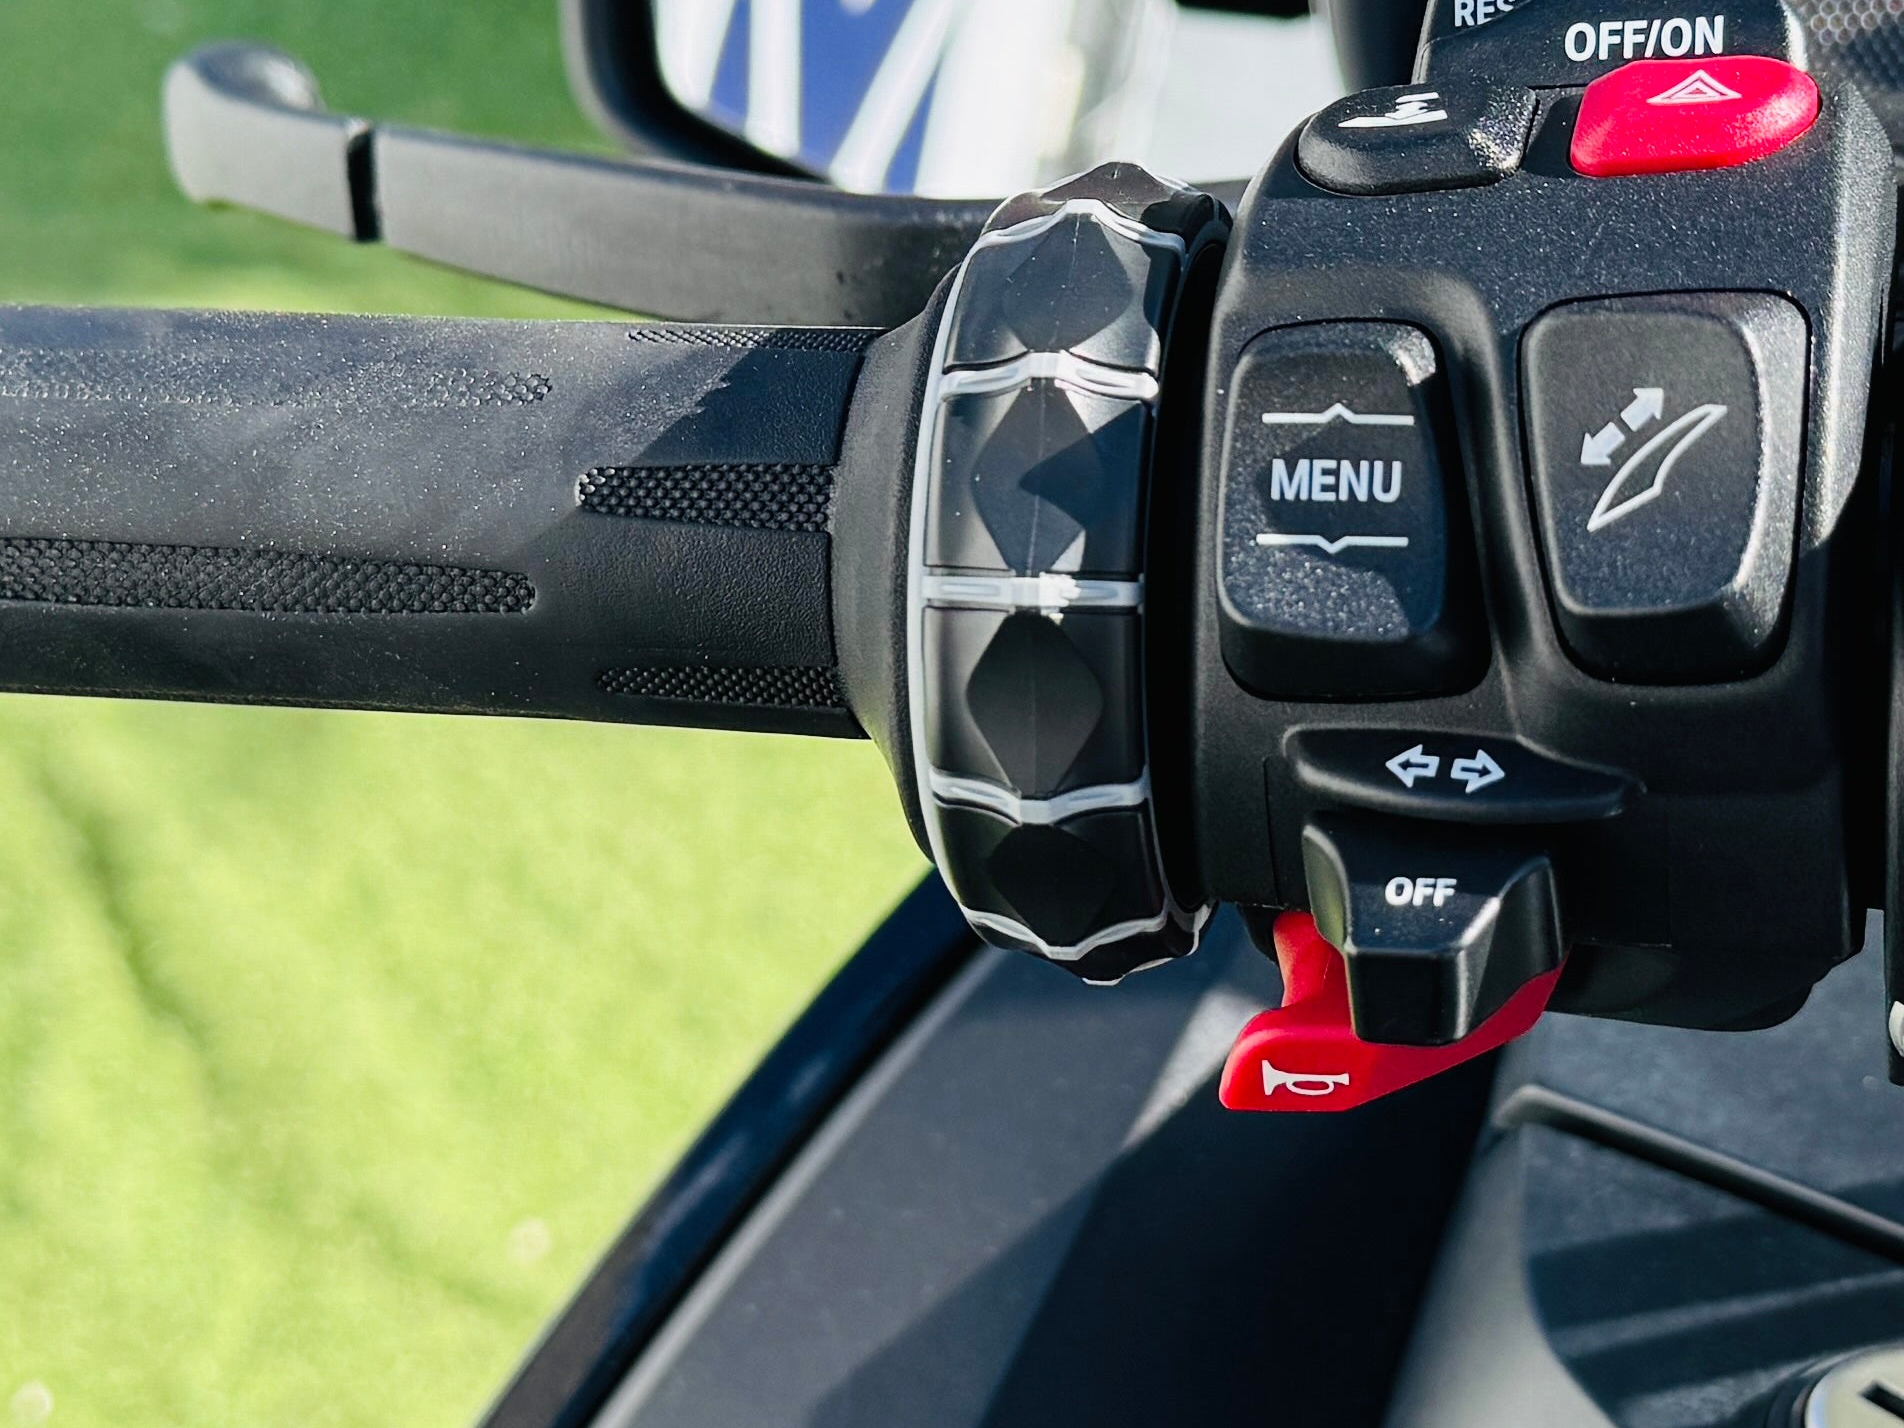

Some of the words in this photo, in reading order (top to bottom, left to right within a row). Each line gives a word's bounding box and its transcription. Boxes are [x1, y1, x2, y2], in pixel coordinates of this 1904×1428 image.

[1564, 15, 1725, 62] OFF/ON
[1270, 458, 1402, 503] MENU
[1385, 876, 1457, 906] OFF
